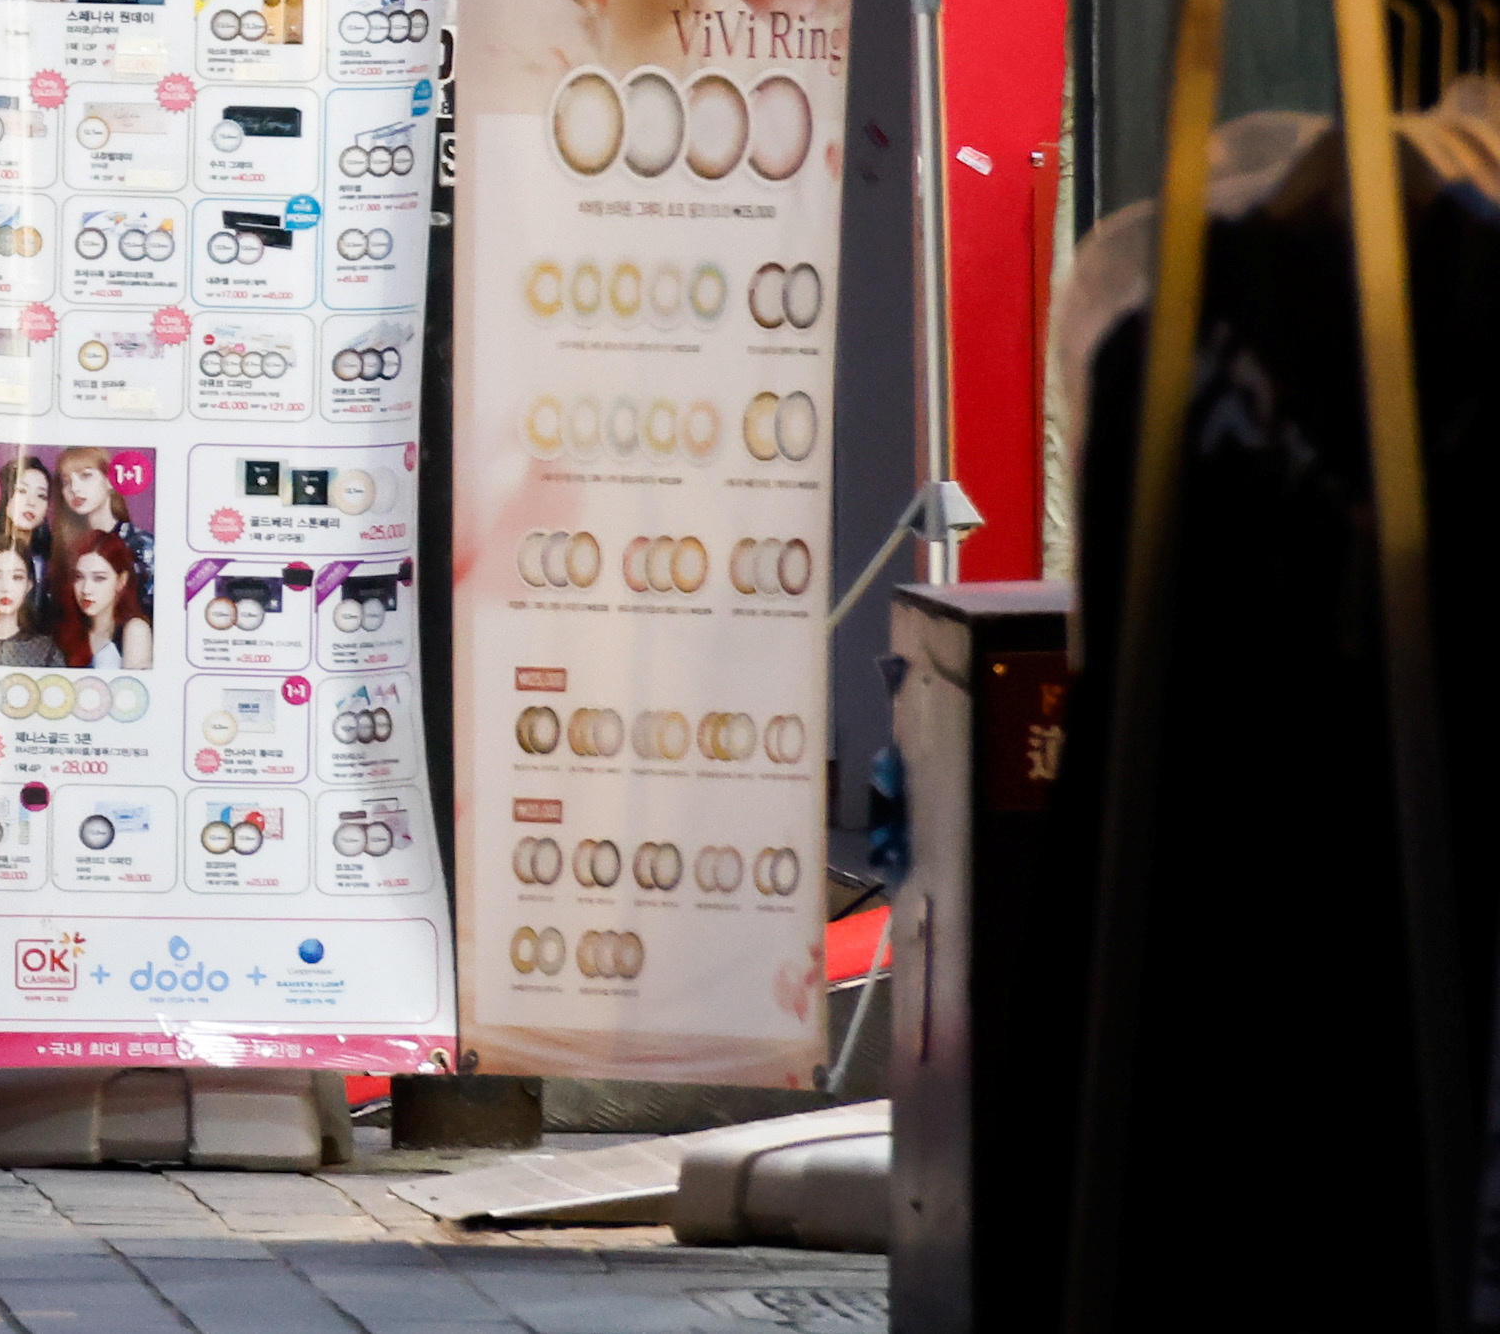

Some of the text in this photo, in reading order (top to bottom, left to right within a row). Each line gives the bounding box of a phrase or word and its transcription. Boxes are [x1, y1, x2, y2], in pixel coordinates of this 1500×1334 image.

[671, 6, 846, 79] ViVi Ring
[114, 464, 145, 485] 1+1
[22, 948, 72, 974] OK
[128, 960, 232, 994] dodo
[49, 1042, 83, 1059] 국내
